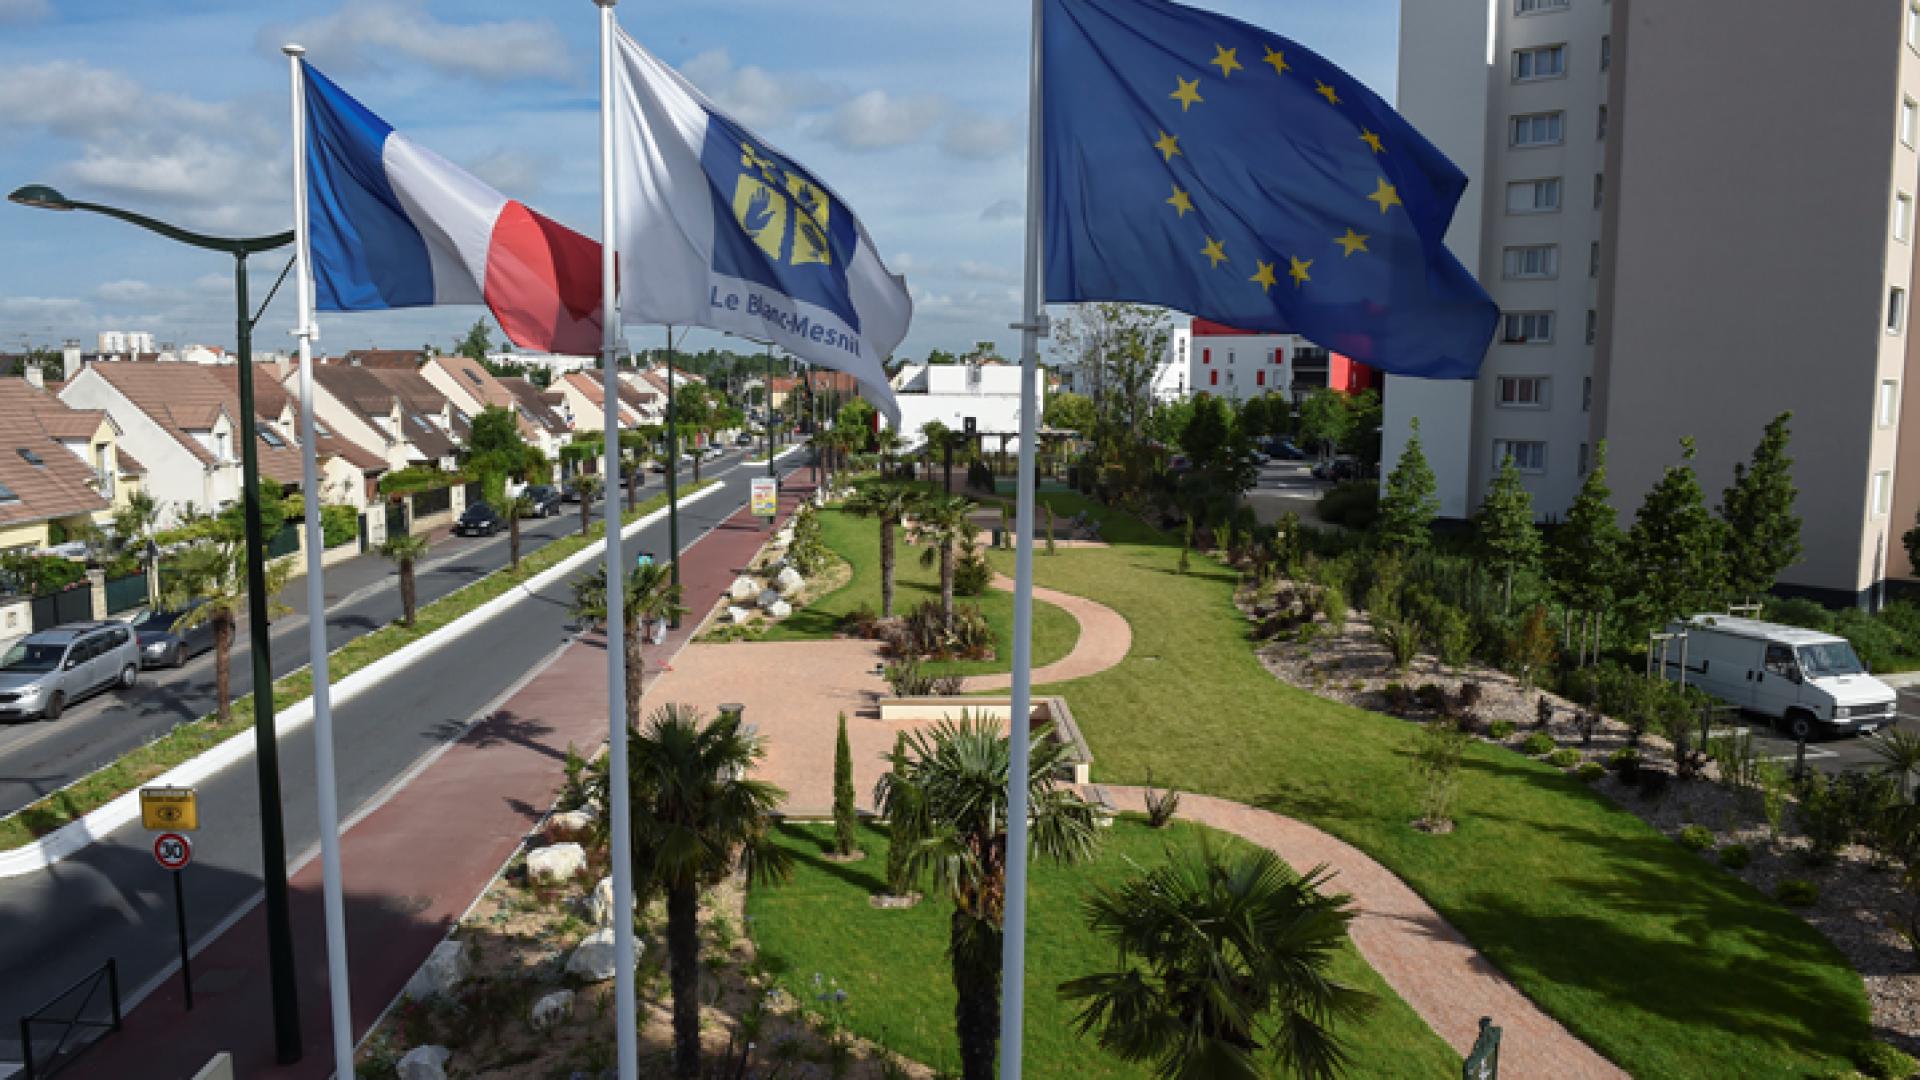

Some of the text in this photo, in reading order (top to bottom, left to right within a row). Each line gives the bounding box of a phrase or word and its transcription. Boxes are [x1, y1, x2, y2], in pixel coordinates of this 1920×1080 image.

[710, 285, 861, 358] Le Blanc-Mesnil
[162, 842, 183, 859] 30
